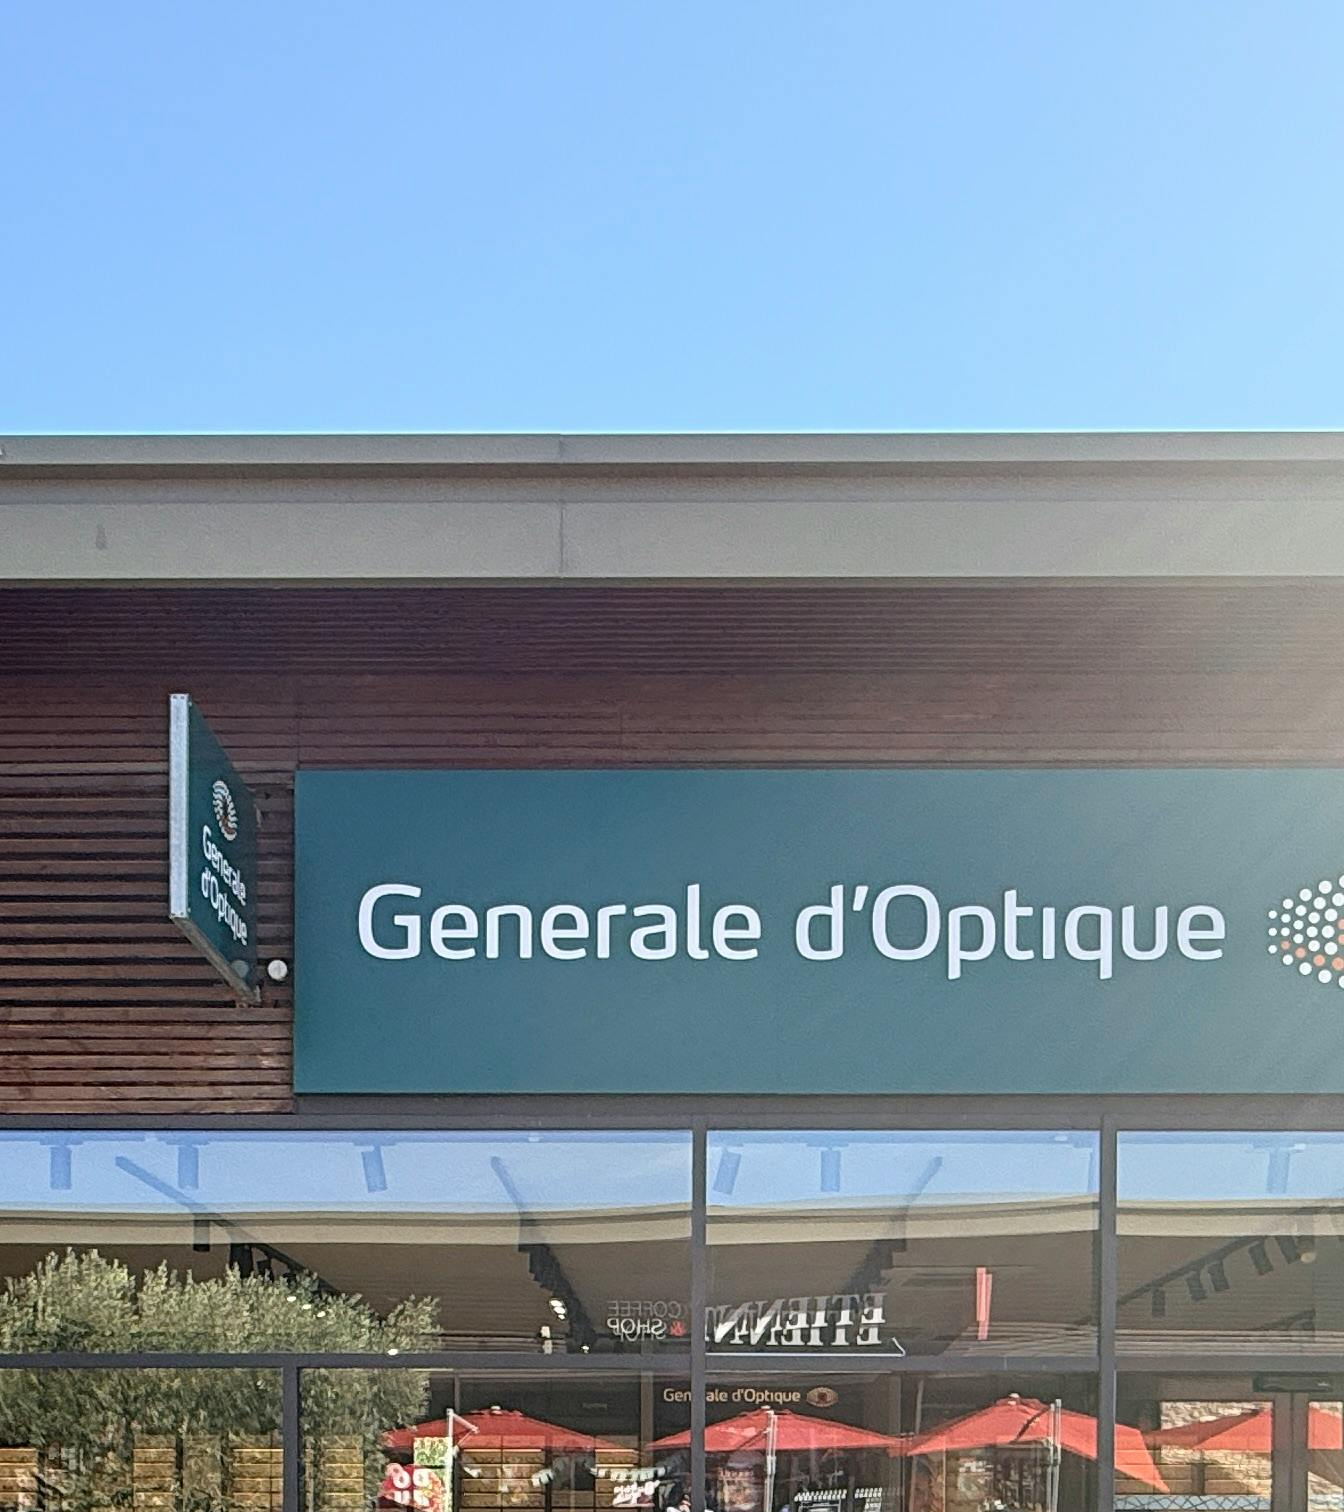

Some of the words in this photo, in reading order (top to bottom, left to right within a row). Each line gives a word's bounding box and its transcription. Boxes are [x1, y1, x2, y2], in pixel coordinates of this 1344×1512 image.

[202, 825, 246, 906] Generale
[201, 867, 248, 946] d'Optique
[358, 883, 762, 960] Generale
[795, 884, 1226, 980] d'Optique
[663, 1388, 729, 1402] Genale
[732, 1388, 801, 1404] d'Optique
